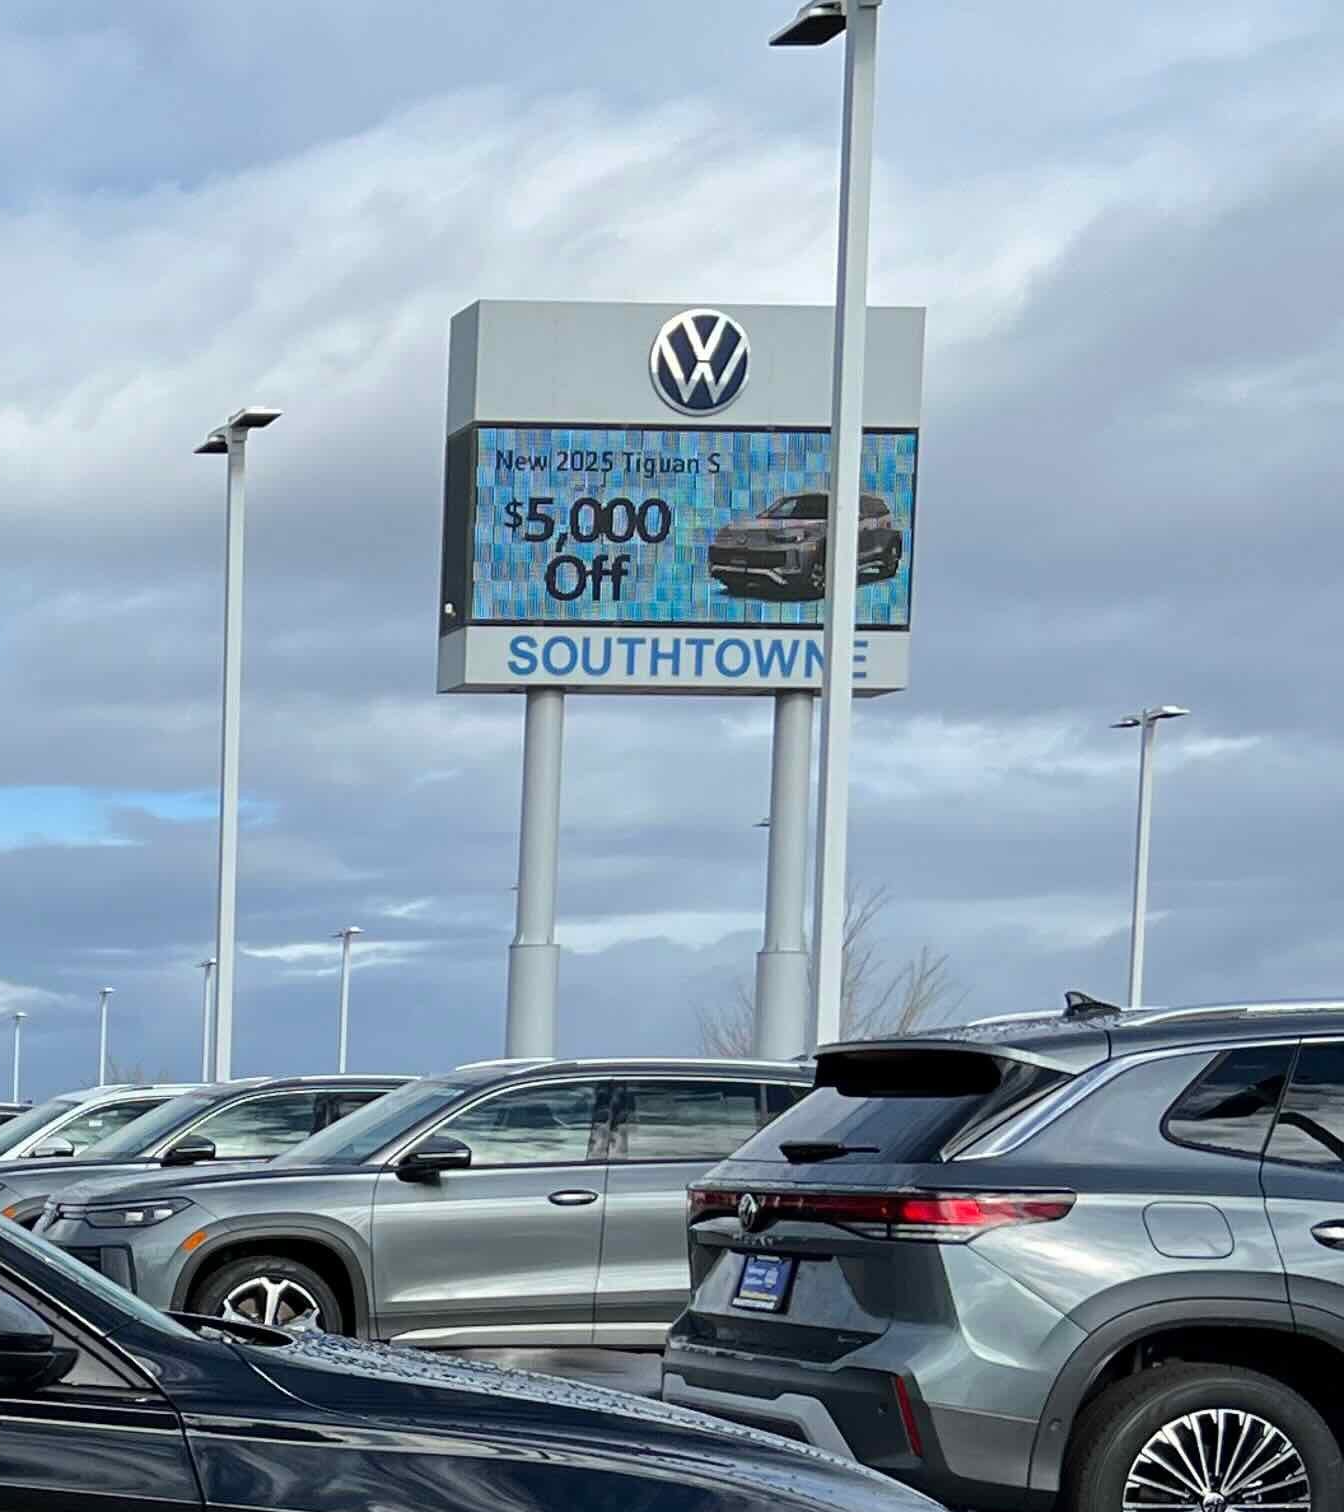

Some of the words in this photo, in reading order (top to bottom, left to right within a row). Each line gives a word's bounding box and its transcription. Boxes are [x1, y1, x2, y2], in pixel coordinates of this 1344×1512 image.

[650, 308, 751, 415] VW
[495, 449, 548, 471] New
[556, 450, 612, 472] 2025
[623, 451, 699, 479] Tiguan
[707, 452, 721, 473] S
[504, 497, 672, 552] $5,000
[545, 554, 630, 601] Off
